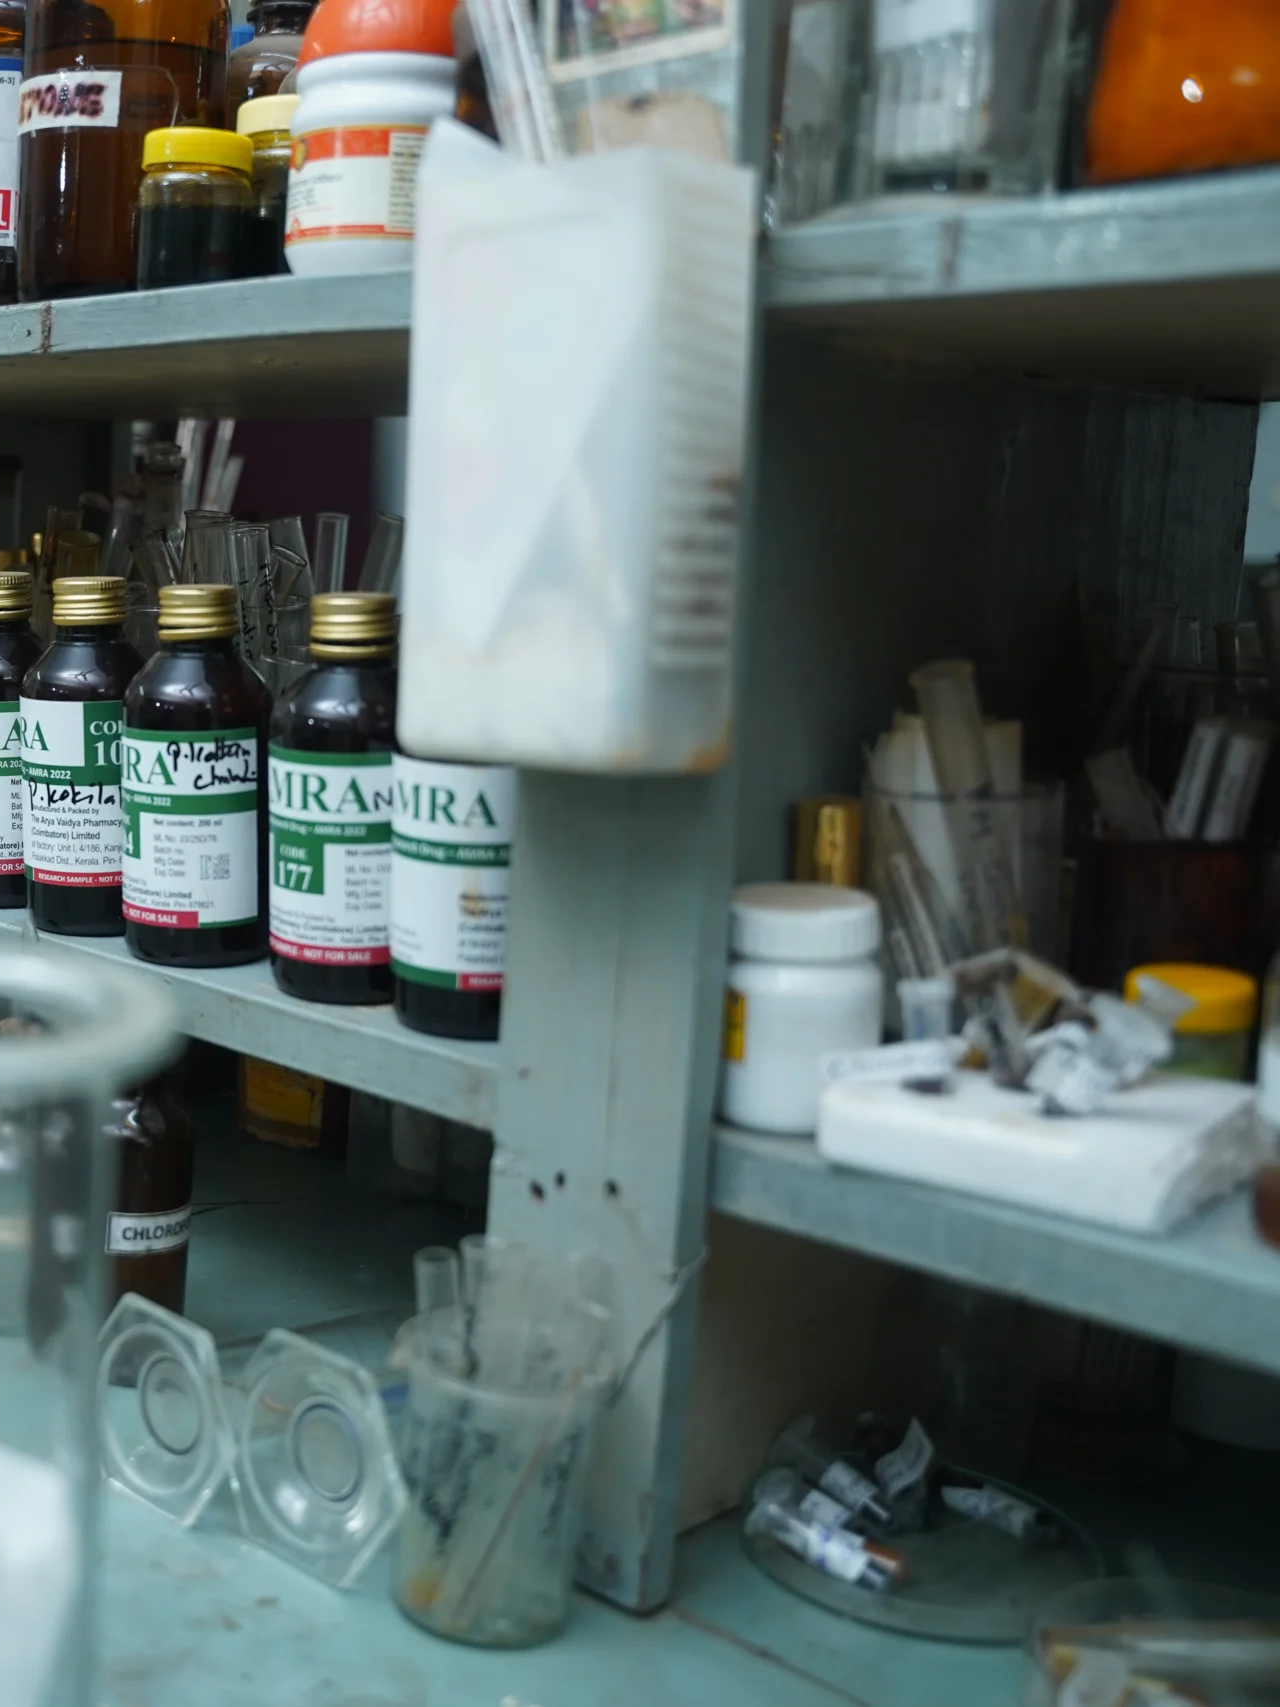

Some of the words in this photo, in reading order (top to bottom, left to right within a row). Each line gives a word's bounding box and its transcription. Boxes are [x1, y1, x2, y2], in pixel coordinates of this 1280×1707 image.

[29, 767, 49, 778] AMRA
[50, 770, 72, 780] 2022
[67, 806, 90, 815] Packed
[91, 806, 100, 815] by
[31, 813, 40, 824] The
[40, 816, 55, 827] Arya
[56, 817, 81, 828] Vaidya
[83, 818, 123, 828] Pharmacy
[31, 826, 70, 841] (Coimbatore)
[71, 831, 101, 840] Limited
[343, 825, 367, 837] 2022
[36, 841, 56, 853] factory:
[57, 844, 71, 852] Unit
[279, 844, 308, 861] CODE
[31, 851, 55, 864] Palakkad
[38, 872, 65, 883] RESEARCH
[66, 875, 93, 884] SAMPLE
[278, 859, 314, 892] 177
[163, 891, 193, 899] Limited
[141, 911, 157, 921] FOR
[157, 913, 178, 924] SALE
[303, 947, 324, 959] NOT
[324, 949, 345, 961] FOR
[346, 950, 372, 962] SALE
